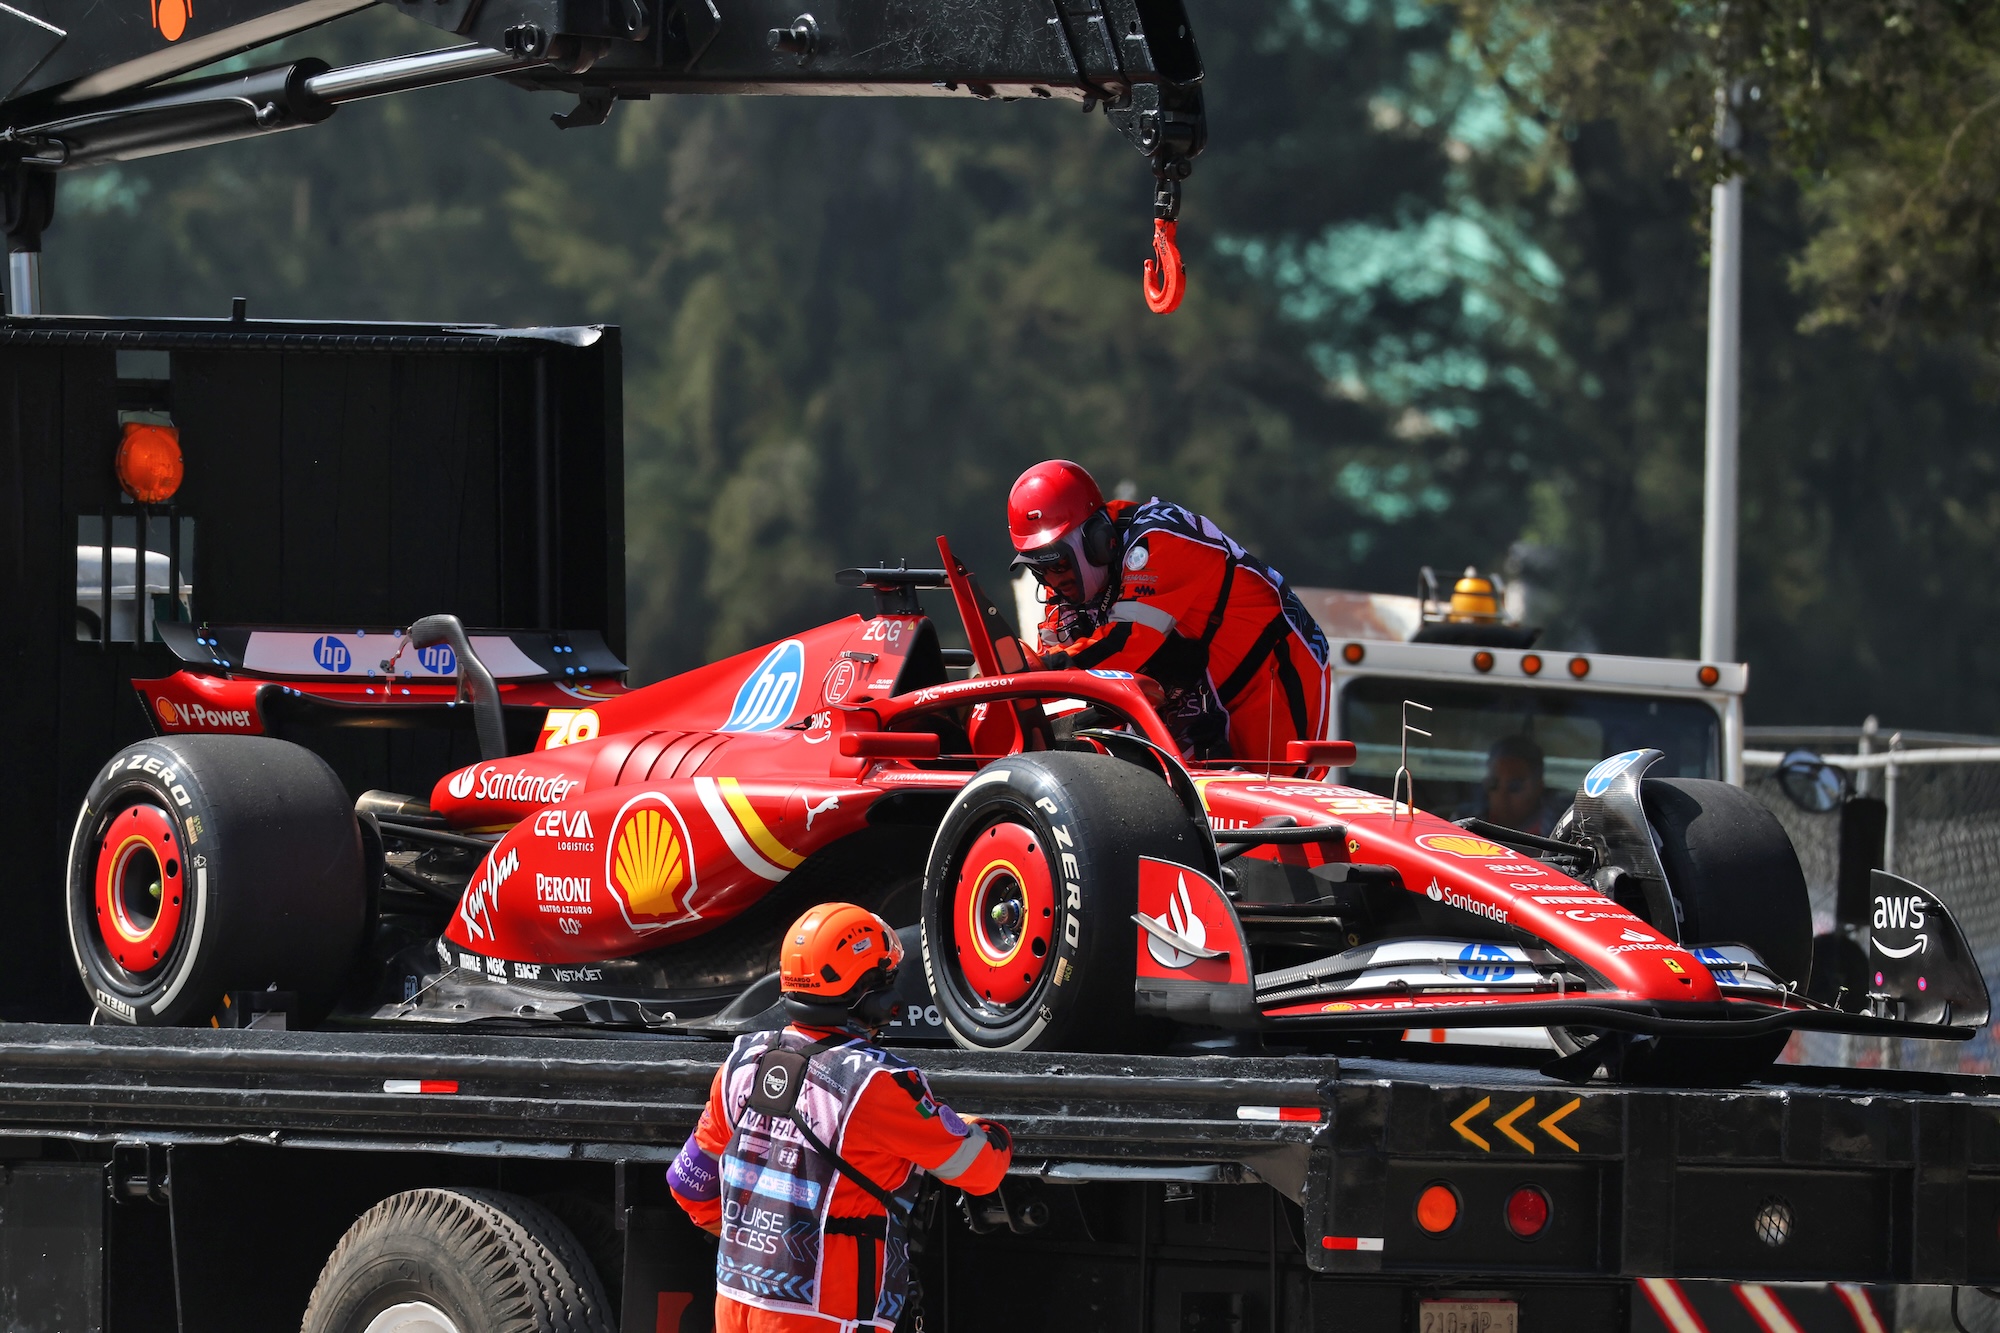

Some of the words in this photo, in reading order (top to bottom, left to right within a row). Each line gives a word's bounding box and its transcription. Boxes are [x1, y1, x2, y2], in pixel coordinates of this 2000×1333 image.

[862, 620, 902, 642] ZCG
[319, 636, 347, 673] hp
[731, 641, 798, 732] hp
[943, 678, 1015, 694] TECHNOLOGY
[174, 702, 251, 728] V-Power
[108, 758, 125, 780] P
[127, 755, 191, 807] ZERO
[475, 766, 579, 804] Santander
[1589, 753, 1631, 794] hp
[557, 841, 594, 852] LOGISTICS
[536, 872, 591, 903] PERONI
[1035, 796, 1058, 815] P
[1052, 824, 1081, 949] ZERO
[539, 904, 561, 913] NASTRO
[562, 905, 593, 915] AZZURRO
[1444, 887, 1509, 925] Santander
[1873, 896, 1924, 930] aws
[459, 953, 481, 972] MAHLE
[1606, 942, 1686, 957] Santande
[486, 956, 507, 977] NGK
[514, 963, 541, 980] SKF
[96, 988, 137, 1025] PIRELLI
[808, 1064, 848, 1096] hampionship
[680, 1146, 716, 1182] ECOVERY
[723, 1199, 784, 1234] OURSE
